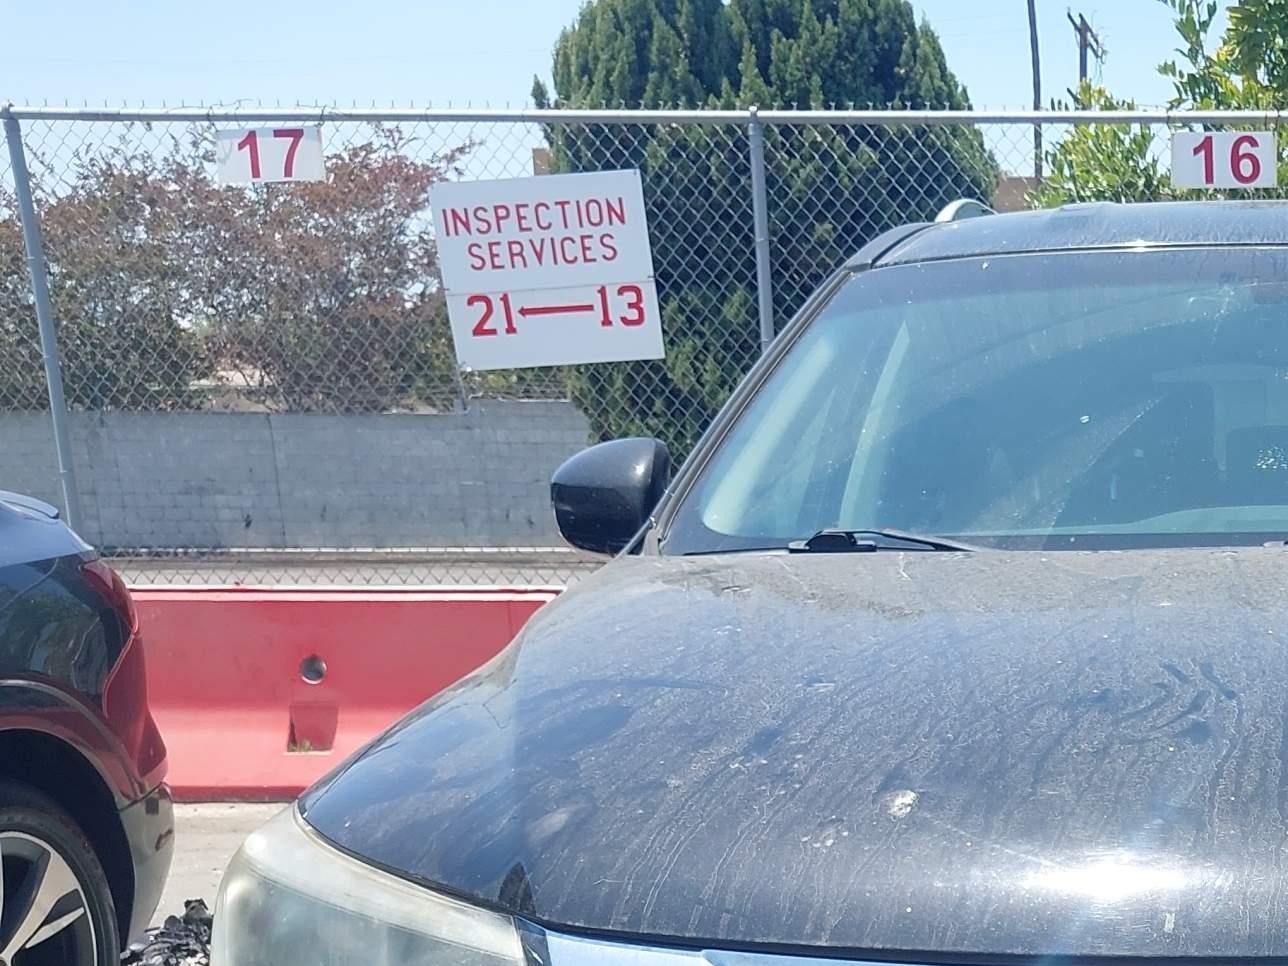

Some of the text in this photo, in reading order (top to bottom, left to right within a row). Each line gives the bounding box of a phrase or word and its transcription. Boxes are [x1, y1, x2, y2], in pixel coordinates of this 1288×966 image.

[237, 128, 304, 179] 17
[1193, 135, 1261, 185] 16
[441, 197, 626, 237] INSPECTION
[467, 233, 618, 271] SERVICES
[467, 284, 645, 337] 21 13
